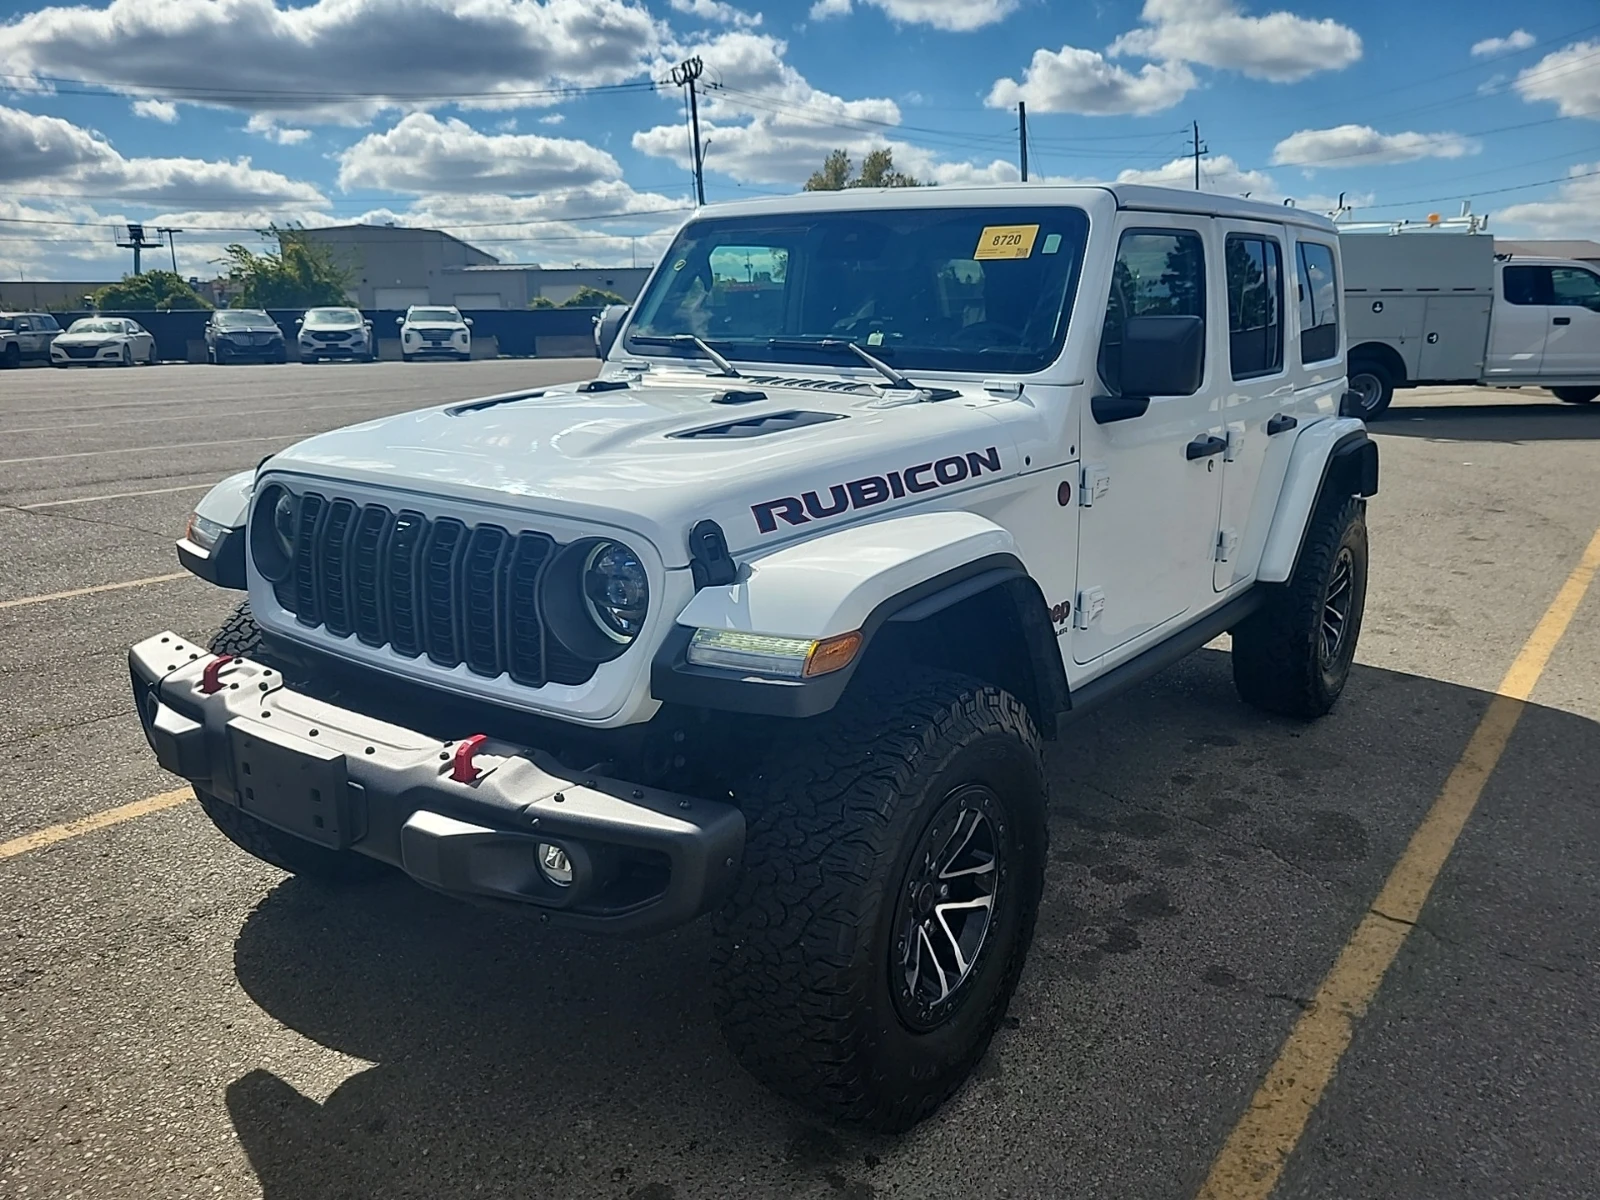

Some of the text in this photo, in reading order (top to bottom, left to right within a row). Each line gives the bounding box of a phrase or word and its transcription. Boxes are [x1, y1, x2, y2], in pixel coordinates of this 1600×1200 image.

[992, 234, 1022, 246] 8720
[750, 446, 1002, 534] RUBICON
[1051, 600, 1071, 625] ep
